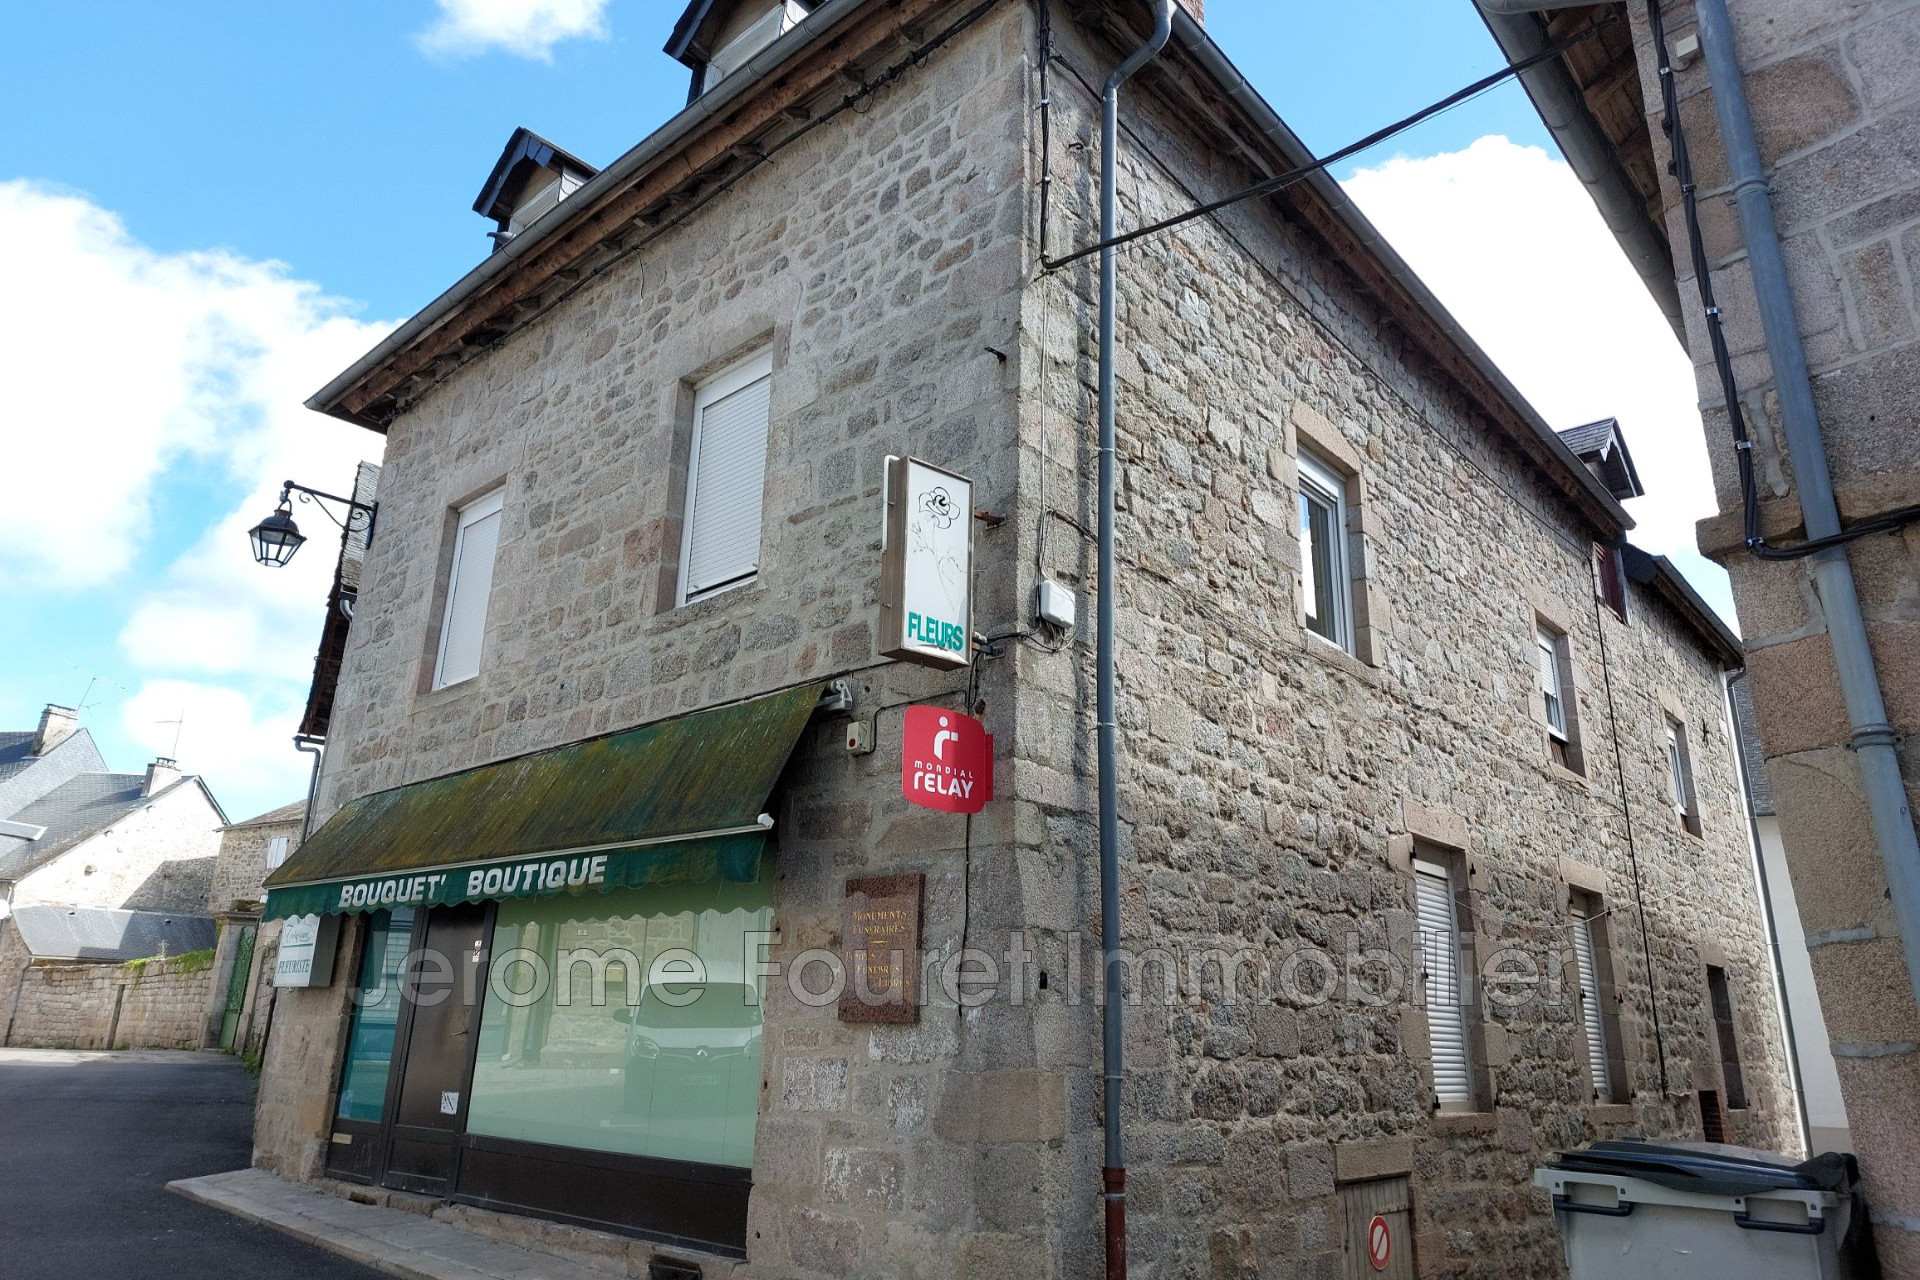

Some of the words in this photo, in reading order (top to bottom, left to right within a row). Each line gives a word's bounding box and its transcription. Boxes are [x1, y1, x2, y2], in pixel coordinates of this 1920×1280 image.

[908, 611, 964, 652] FLEURS
[467, 855, 608, 896] BOUTIQUE
[853, 910, 907, 920] MONUMENTS
[278, 958, 311, 974] FLEURISTE
